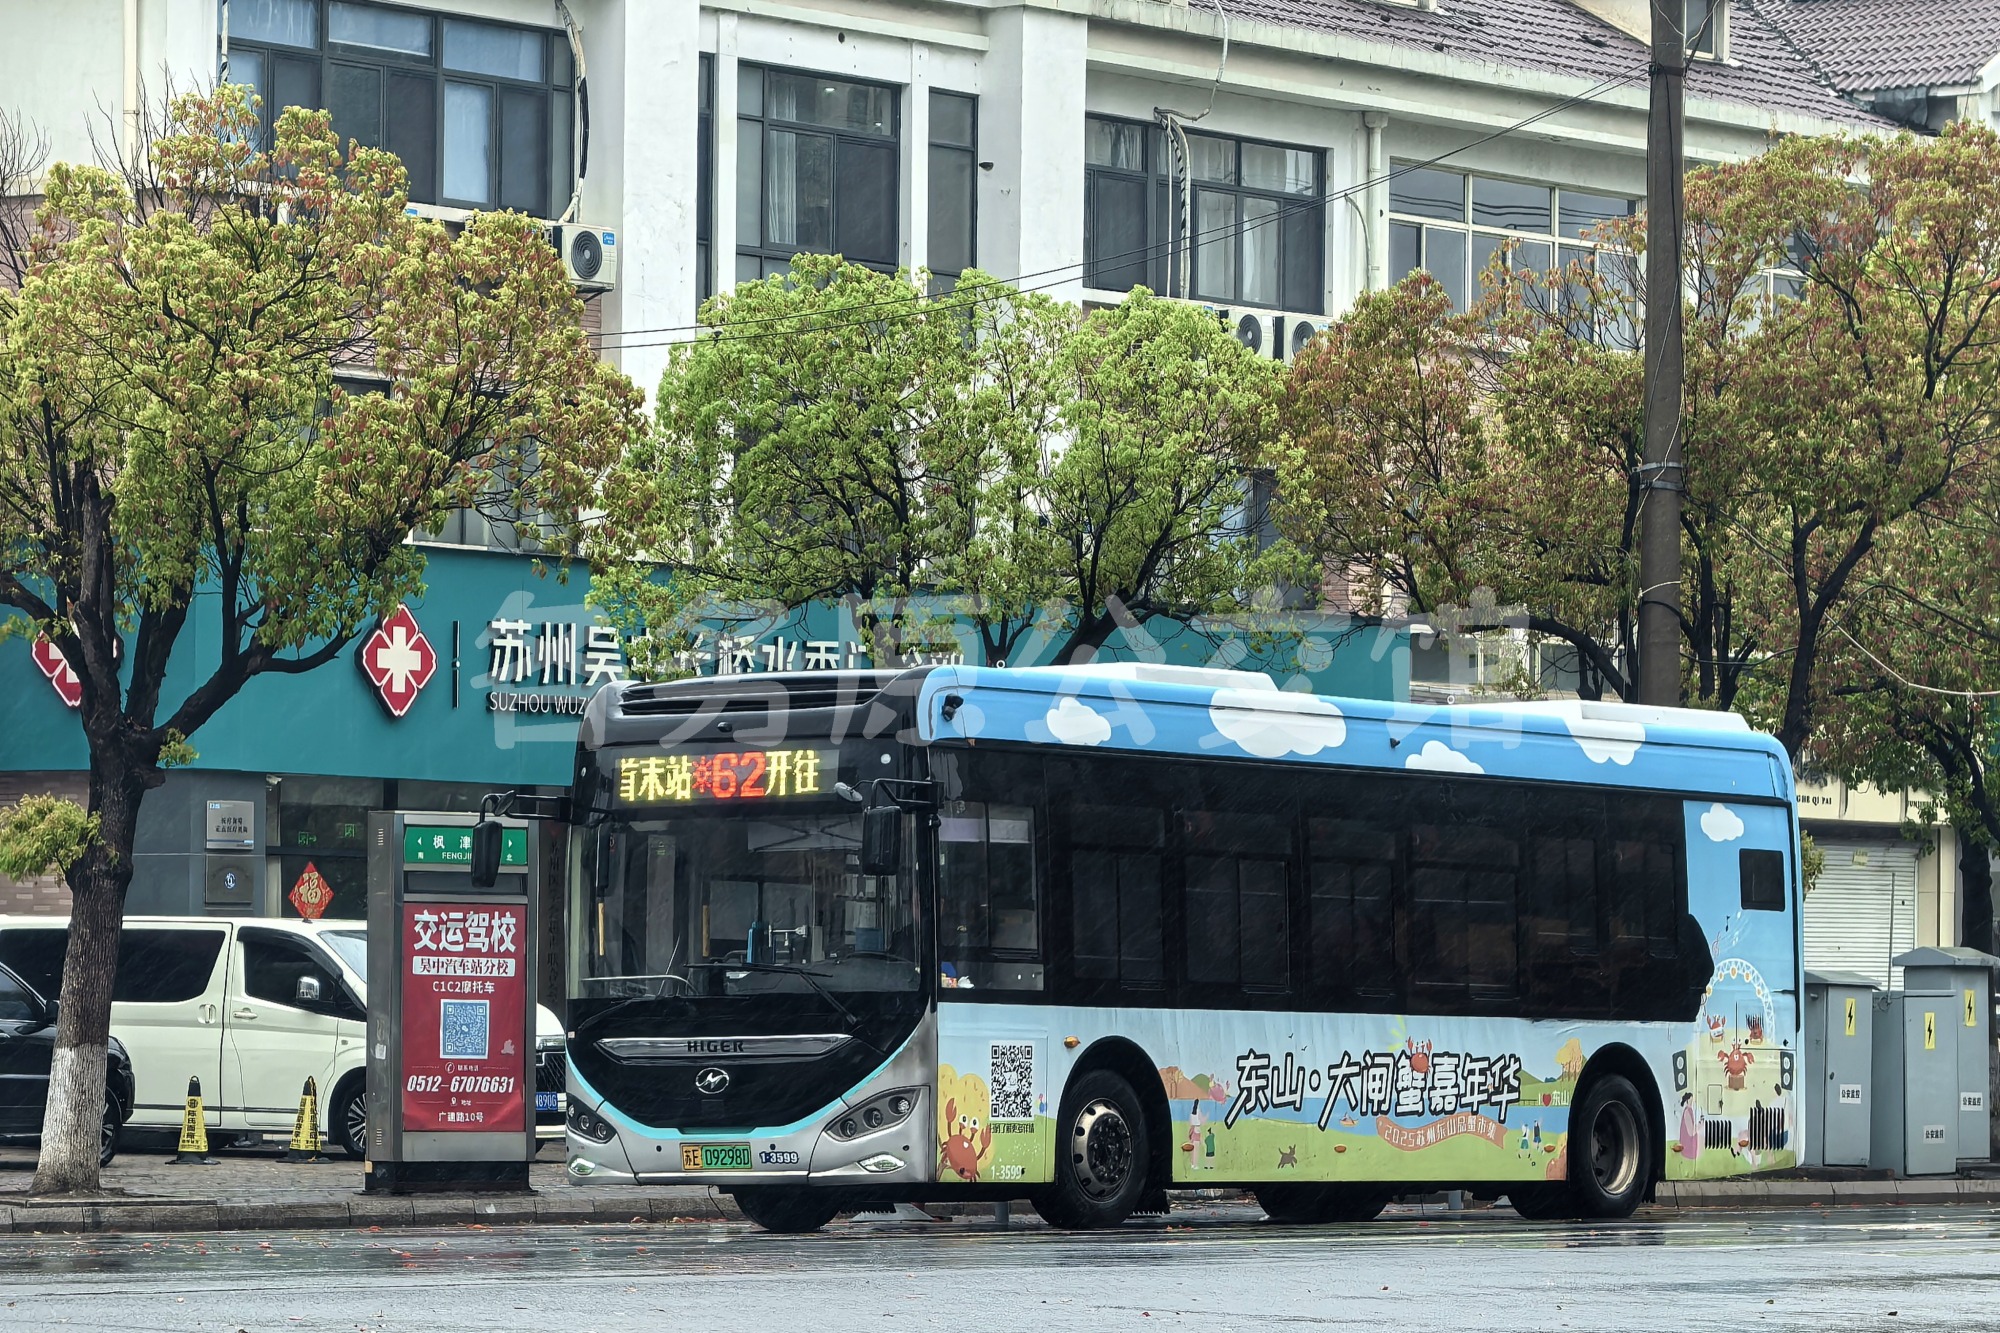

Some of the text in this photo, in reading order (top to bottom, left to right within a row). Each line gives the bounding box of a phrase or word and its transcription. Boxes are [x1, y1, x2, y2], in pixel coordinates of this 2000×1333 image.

[490, 691, 591, 715] SUZHOU WUZ
[299, 871, 322, 904] 福
[413, 909, 517, 953] 交运驾校
[420, 958, 509, 976] 吴中汽车站分校
[432, 980, 496, 994] C1C2摩托车
[687, 1040, 744, 1053] HIGER
[406, 1075, 515, 1093] 0512-67076631
[1552, 1089, 1571, 1106] 东山
[1841, 1089, 1861, 1099] 公安监控
[1962, 1096, 1982, 1106] 公安监控
[991, 1164, 1022, 1179] 1-3599
